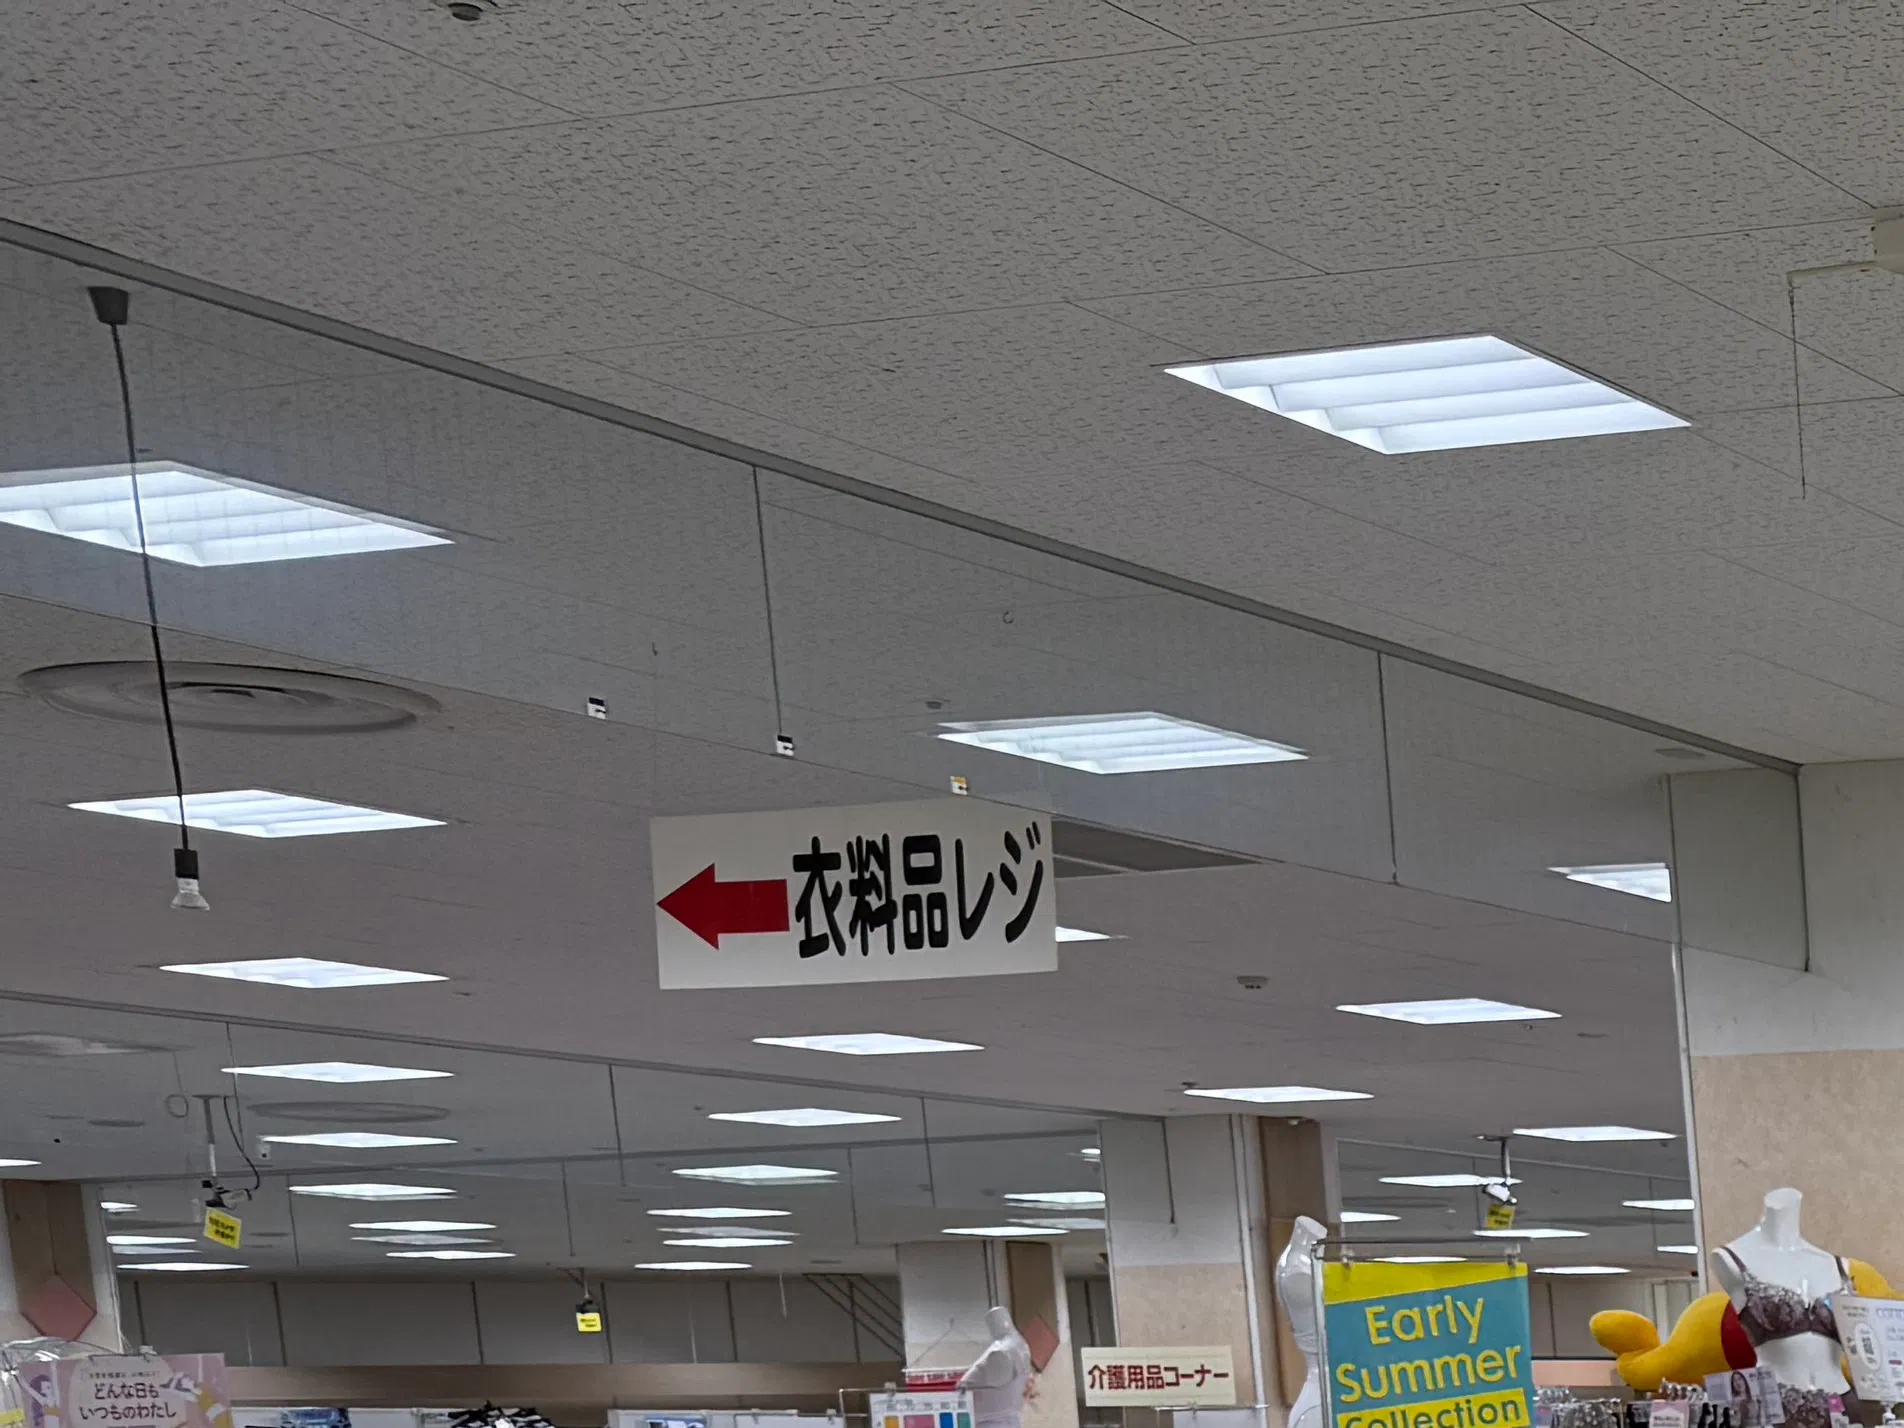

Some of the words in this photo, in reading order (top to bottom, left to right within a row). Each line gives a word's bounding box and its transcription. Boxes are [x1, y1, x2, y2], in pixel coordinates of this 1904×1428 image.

[793, 821, 1044, 959] 衣料品レジ
[1365, 1295, 1485, 1346] Early
[94, 1382, 160, 1399] どんな日も
[1088, 1363, 1230, 1391] 介護用品コーナー
[1336, 1345, 1521, 1404] Summer
[79, 1403, 177, 1421] いつものわたし
